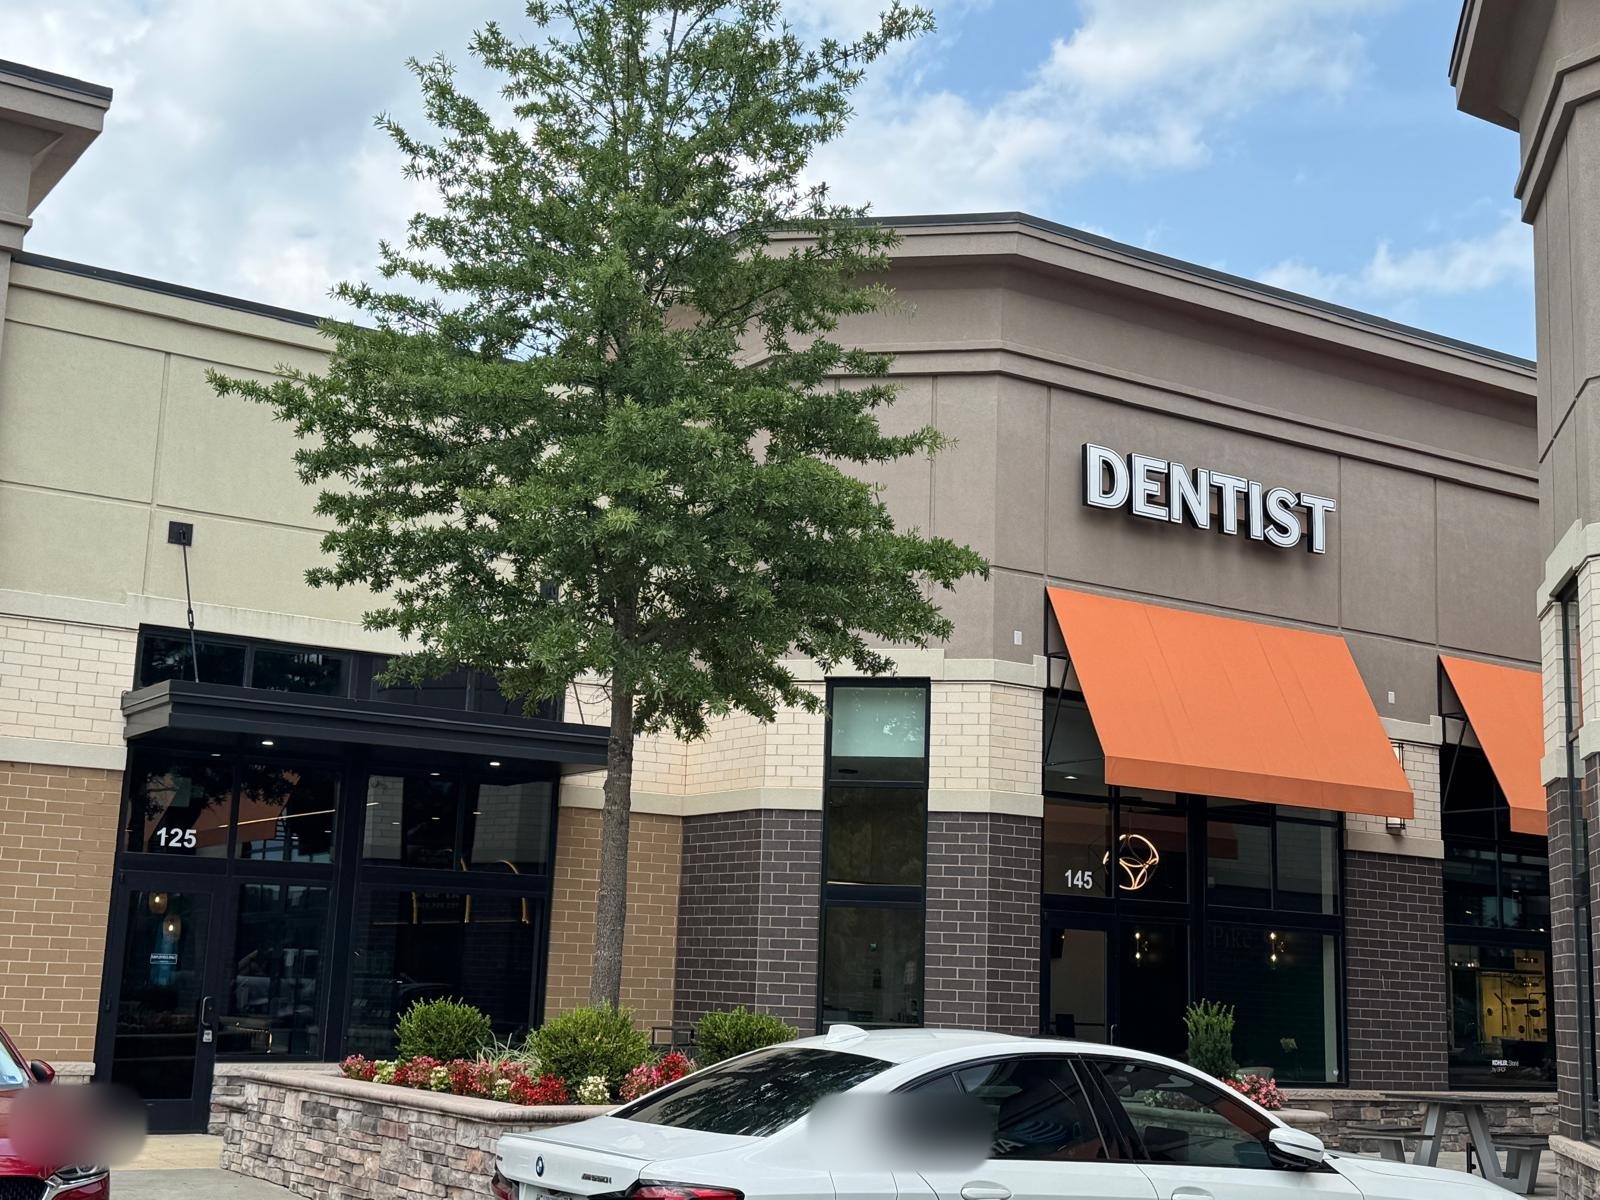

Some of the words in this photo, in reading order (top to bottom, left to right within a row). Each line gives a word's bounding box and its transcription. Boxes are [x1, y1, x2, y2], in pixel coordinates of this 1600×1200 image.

[1082, 442, 1337, 554] DENTIST
[156, 827, 197, 848] 125
[1065, 869, 1093, 889] 145
